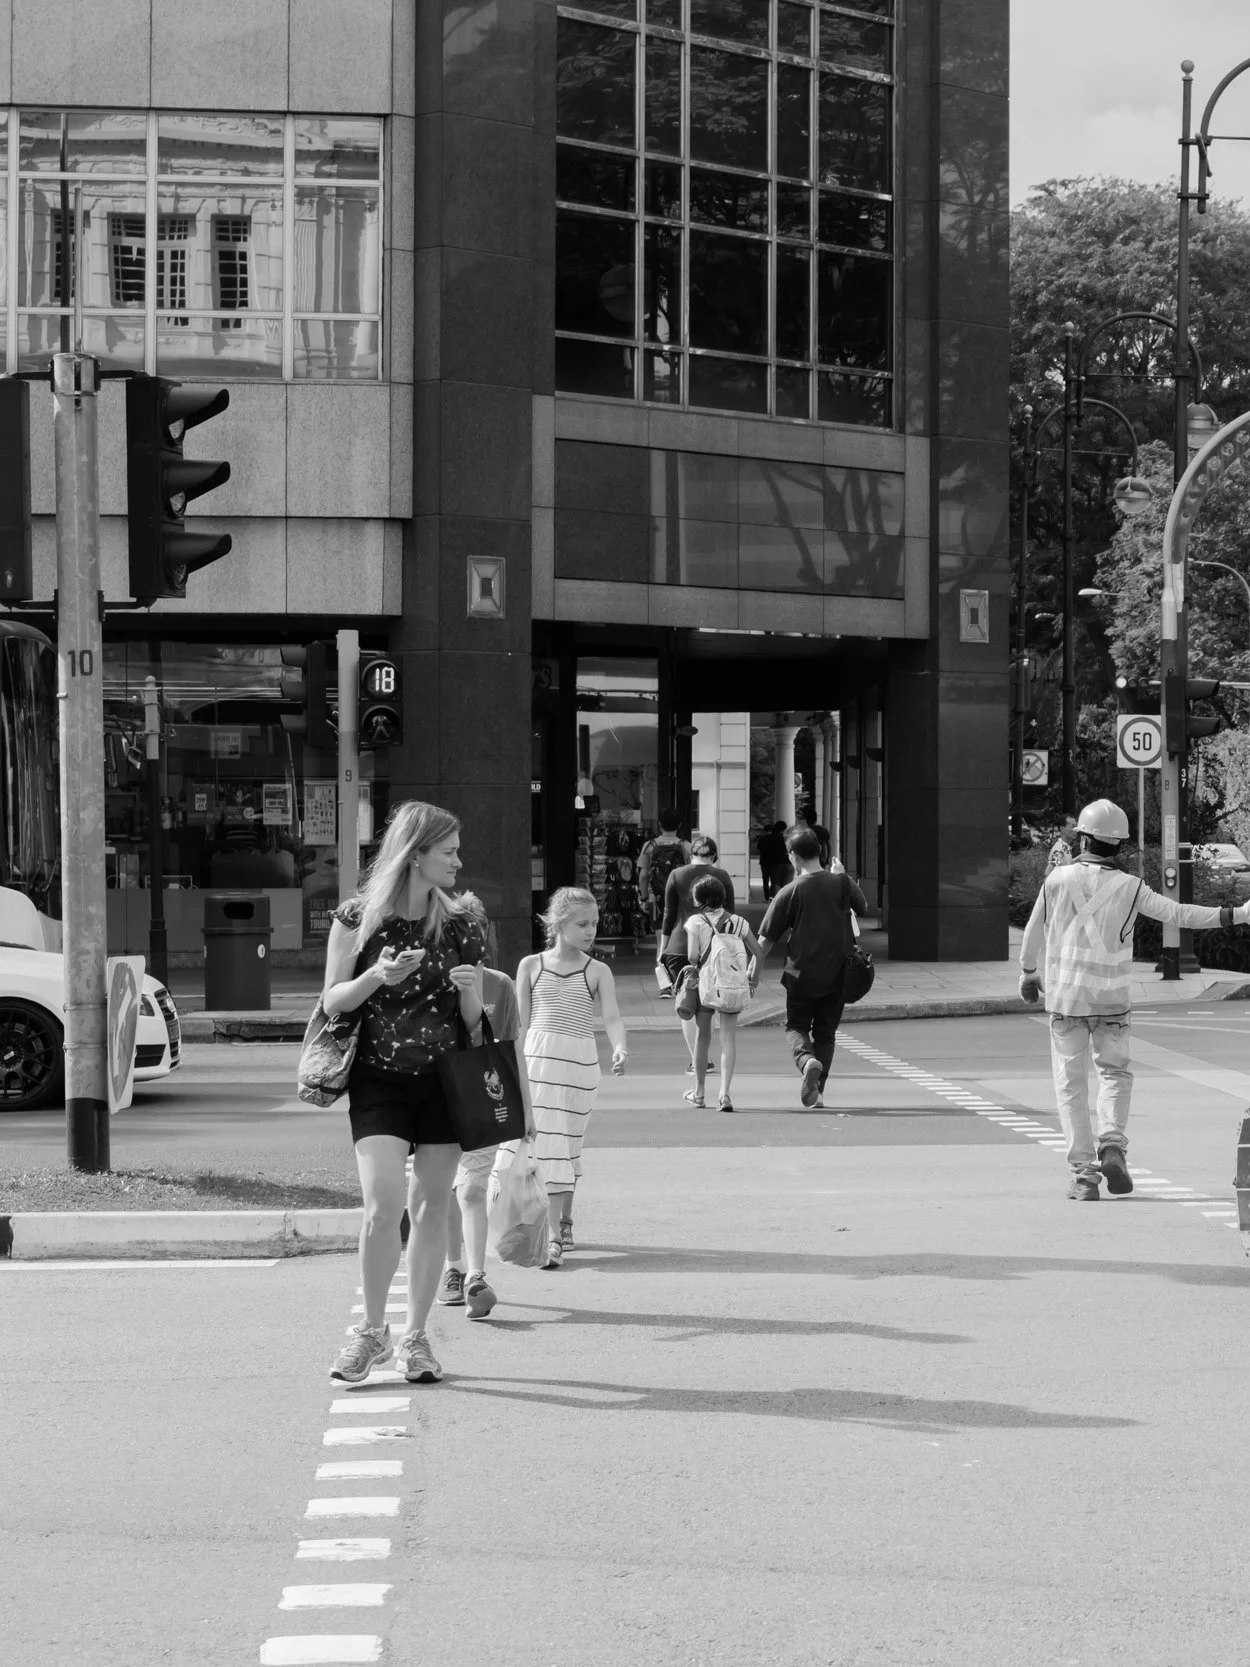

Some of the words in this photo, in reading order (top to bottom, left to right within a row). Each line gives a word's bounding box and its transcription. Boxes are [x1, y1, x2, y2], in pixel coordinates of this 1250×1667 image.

[67, 649, 94, 677] 10
[375, 666, 395, 693] 18
[1132, 732, 1152, 751] 50
[345, 769, 353, 782] 9
